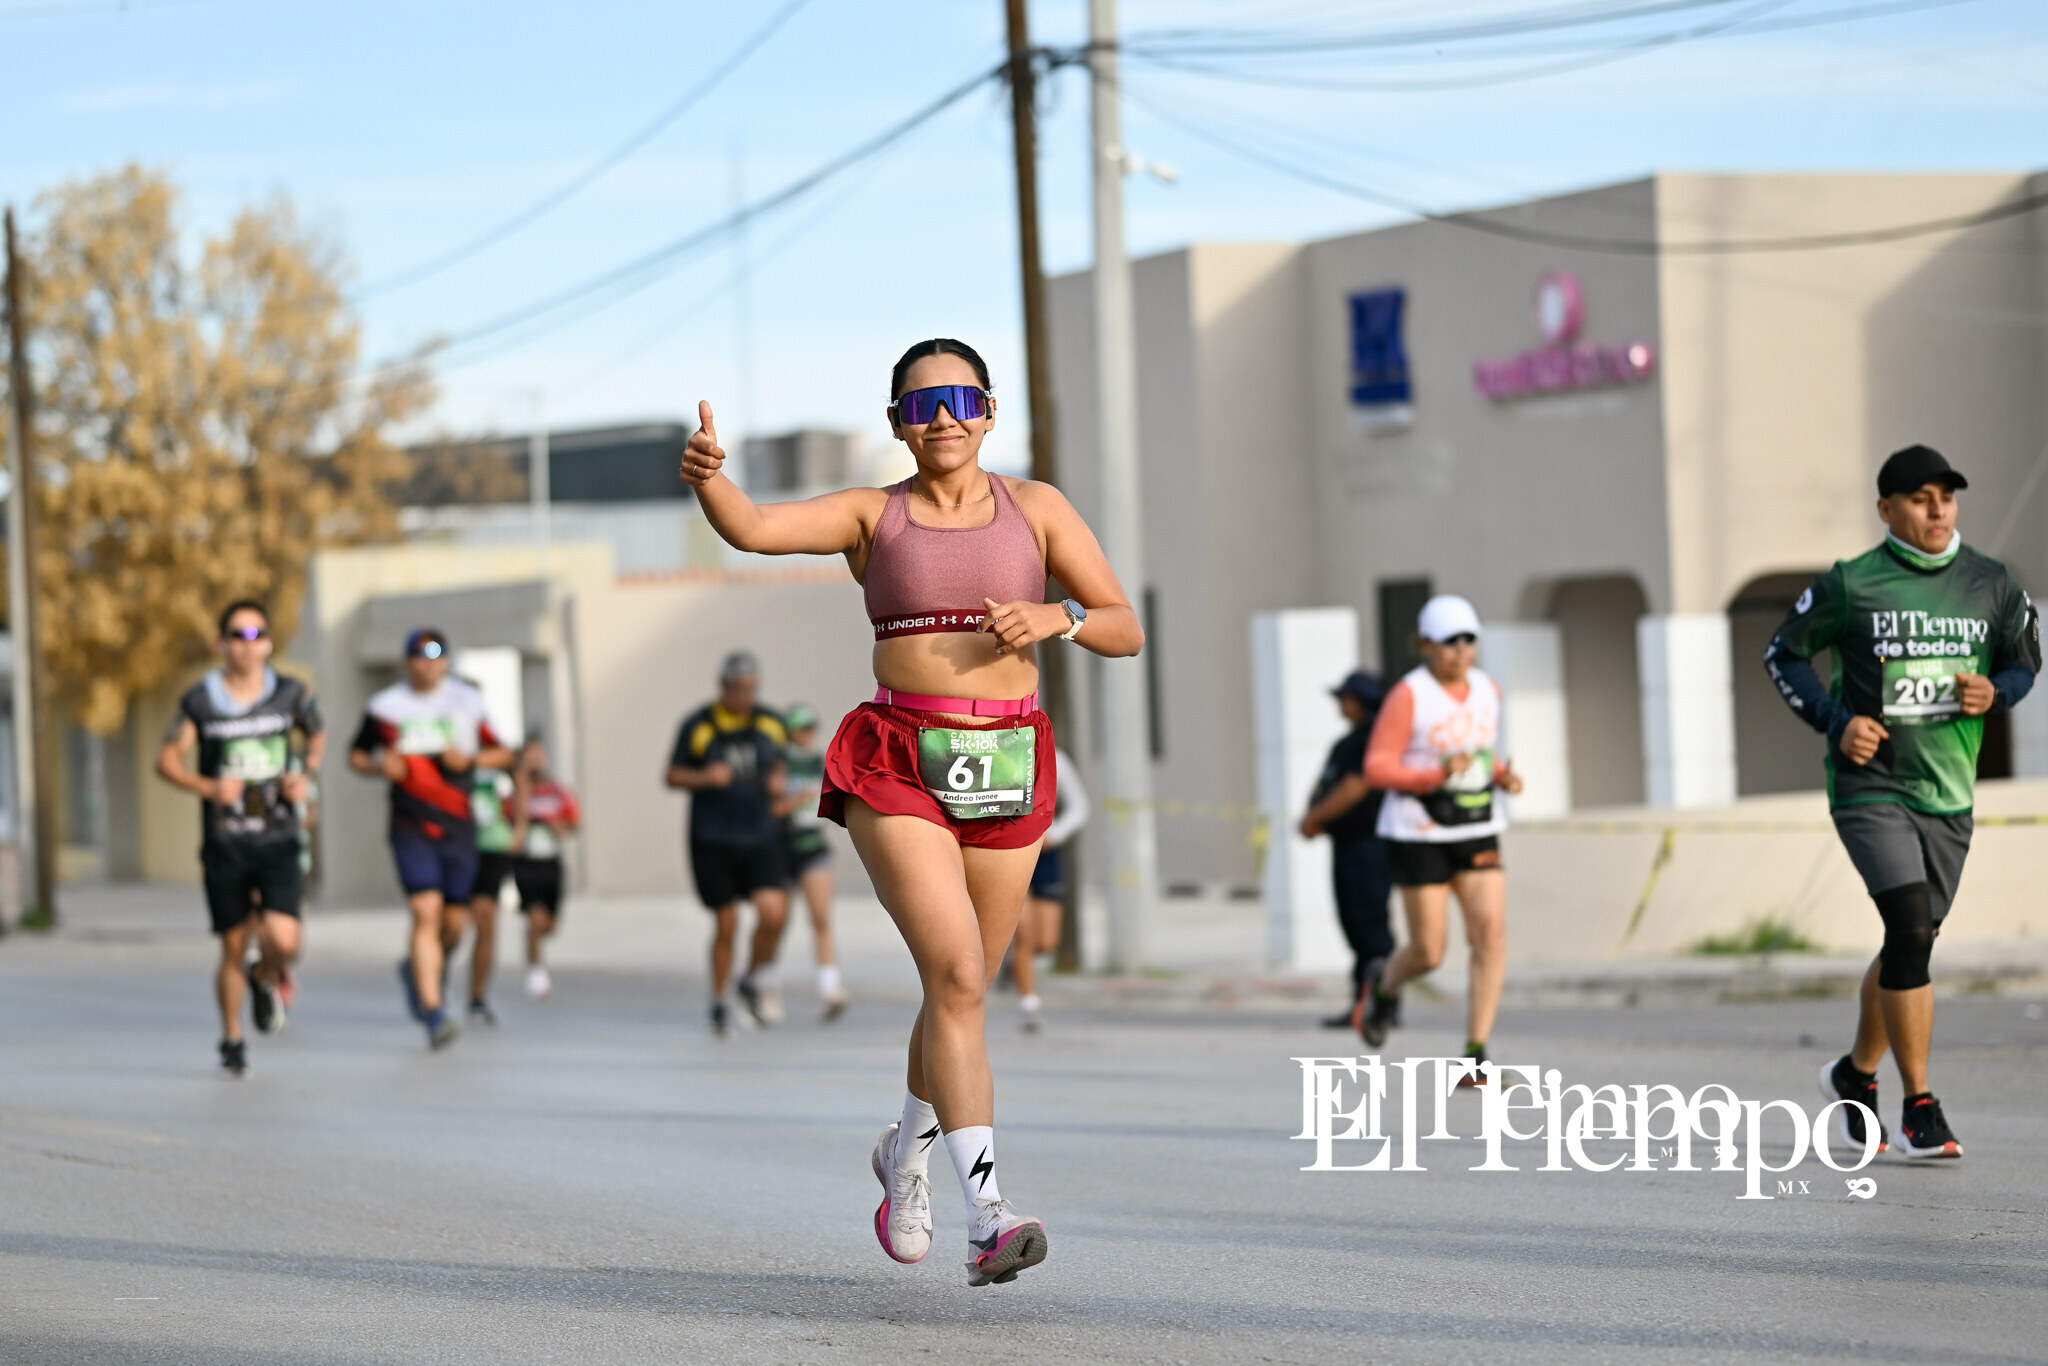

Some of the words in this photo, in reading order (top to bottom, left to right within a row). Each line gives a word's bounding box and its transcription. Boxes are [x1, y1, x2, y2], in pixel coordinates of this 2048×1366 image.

[888, 616, 936, 630] UNDER
[1872, 611, 1898, 638] El
[1901, 610, 1988, 643] Tiempo
[1873, 638, 1903, 657] de
[1906, 638, 1972, 657] todos
[1894, 676, 1955, 705] 202
[950, 732, 998, 740] CARRERA
[947, 755, 993, 791] 61
